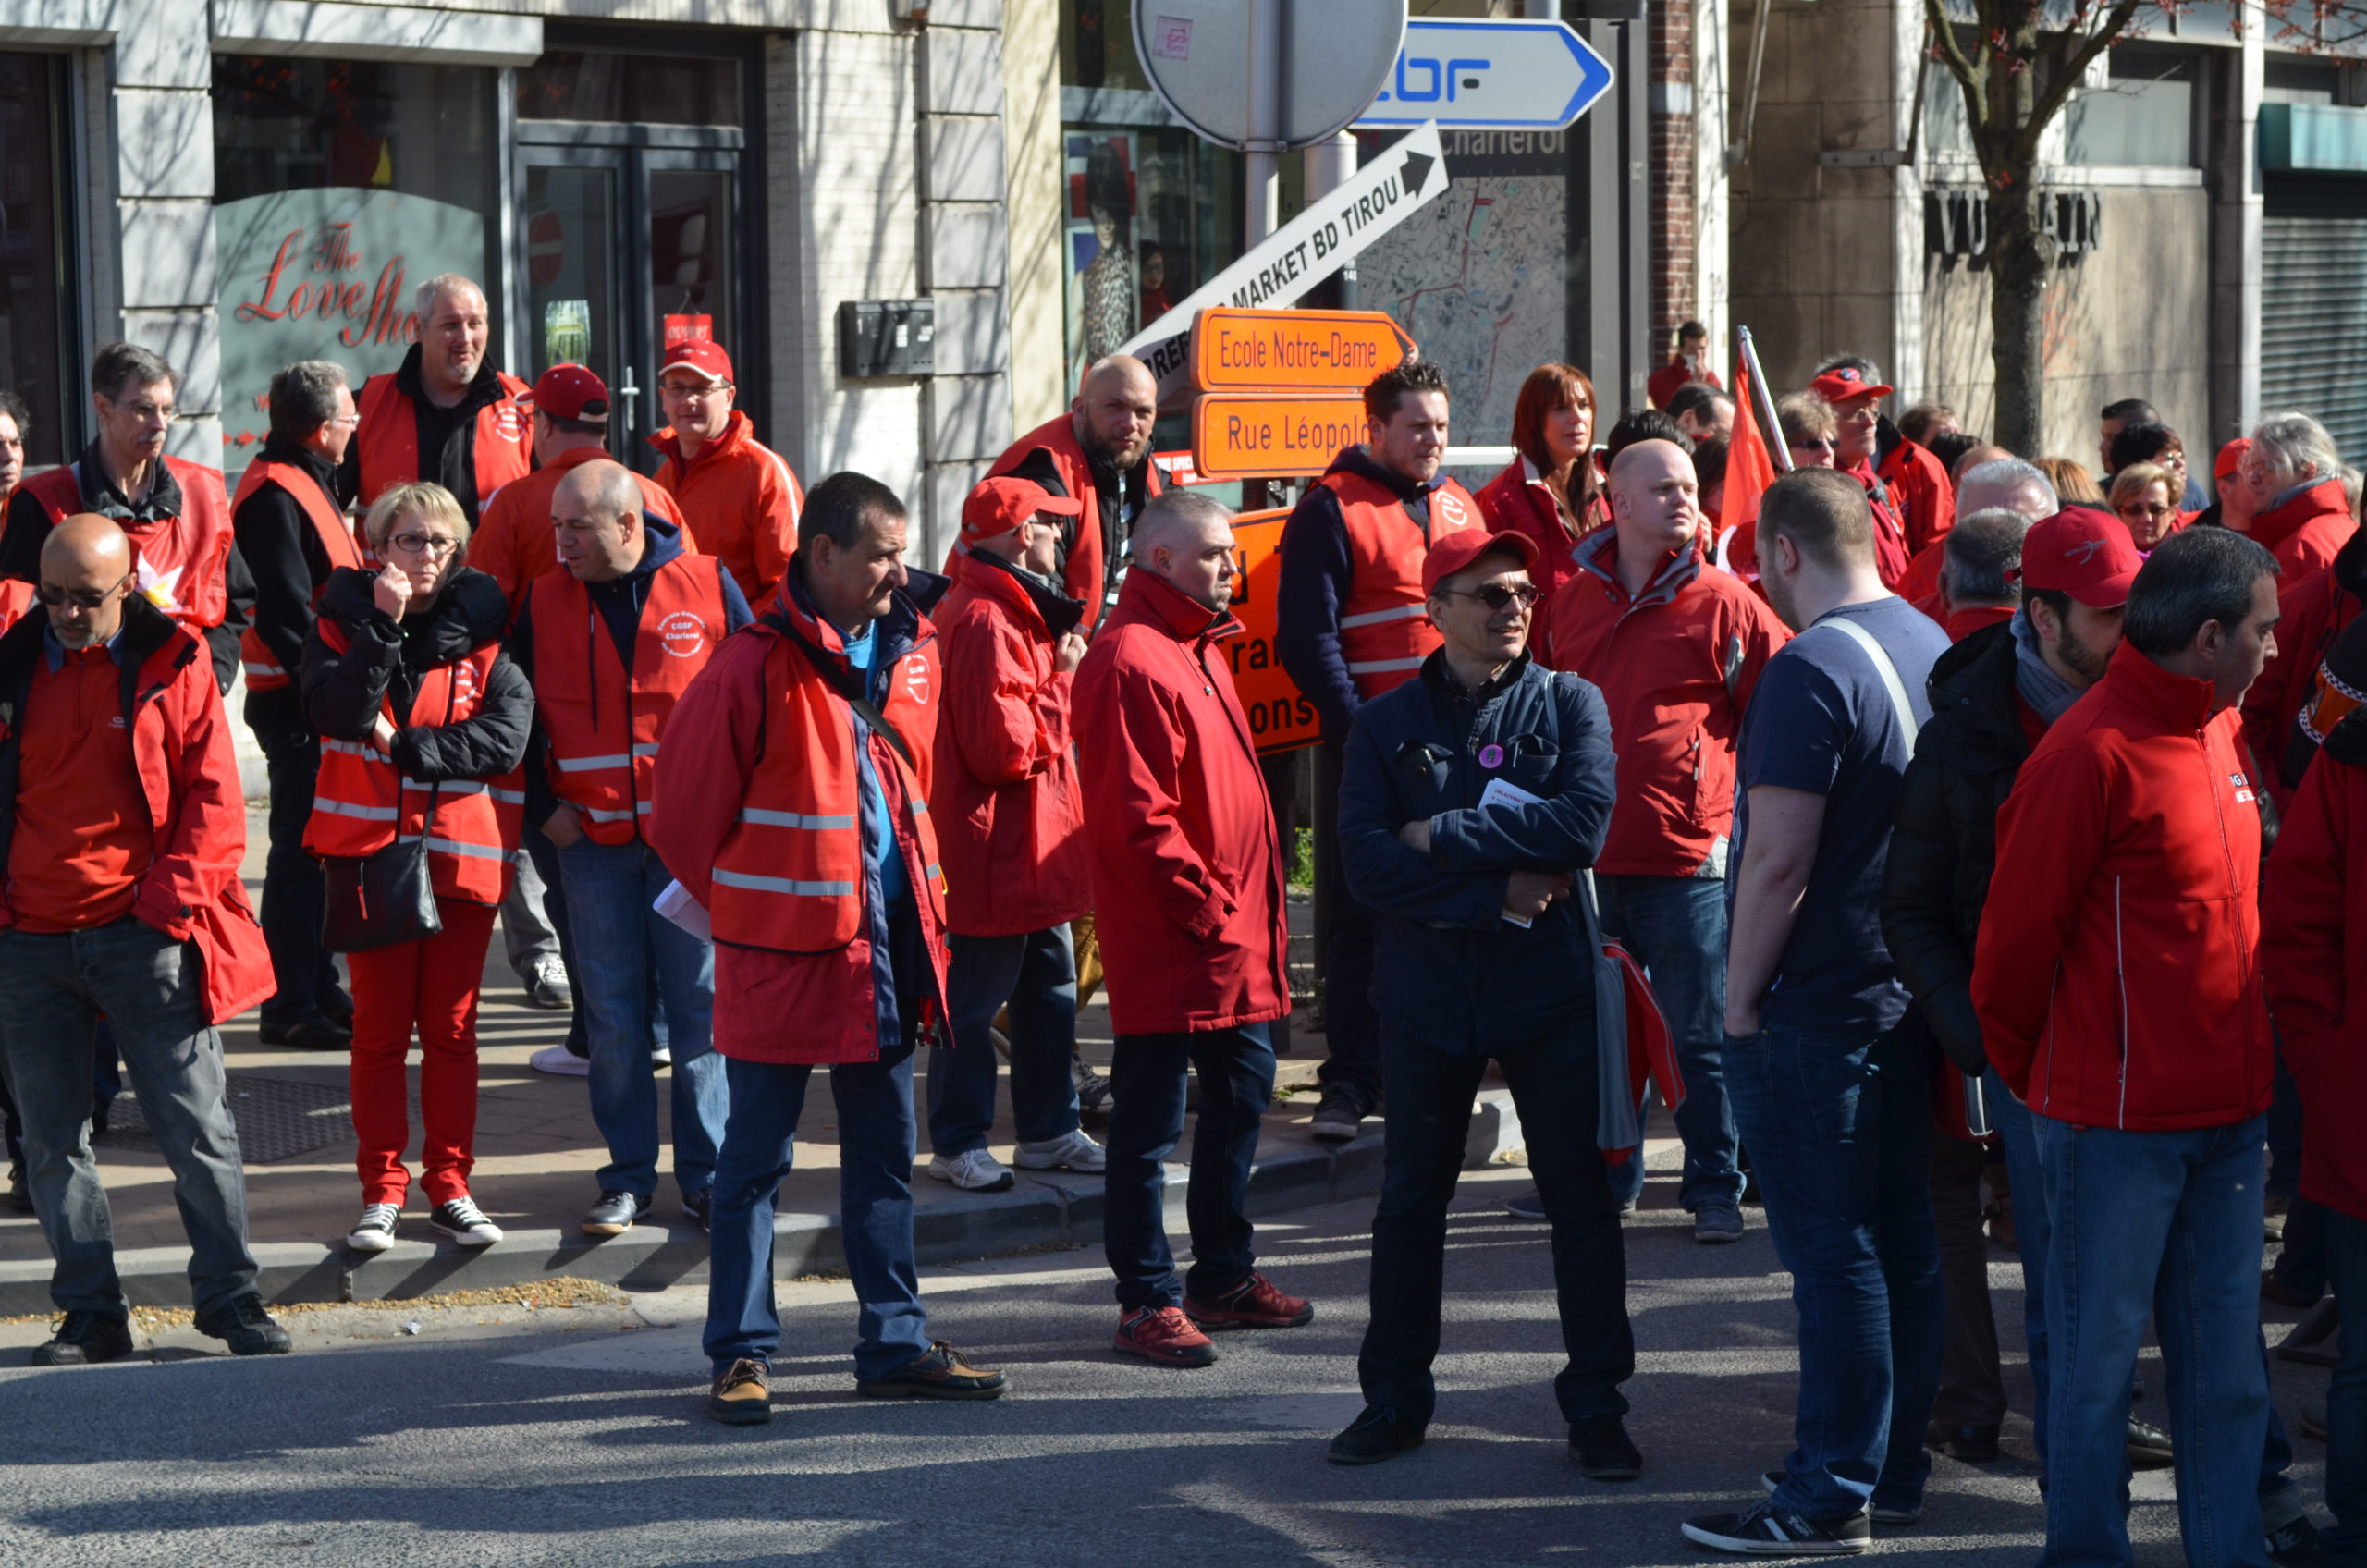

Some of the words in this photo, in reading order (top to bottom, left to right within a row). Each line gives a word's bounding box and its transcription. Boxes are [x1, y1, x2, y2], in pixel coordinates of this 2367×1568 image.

[313, 221, 364, 272] The
[1232, 239, 1306, 309] MARKET
[1312, 221, 1338, 261] BD
[1341, 175, 1398, 237] TIROU
[239, 227, 367, 320] Love
[342, 254, 419, 346] Sho
[668, 325, 709, 340] OUVERT
[1220, 330, 1267, 368] Ecole
[1274, 330, 1378, 368] Notre-Dame
[1228, 415, 1272, 451] Rue
